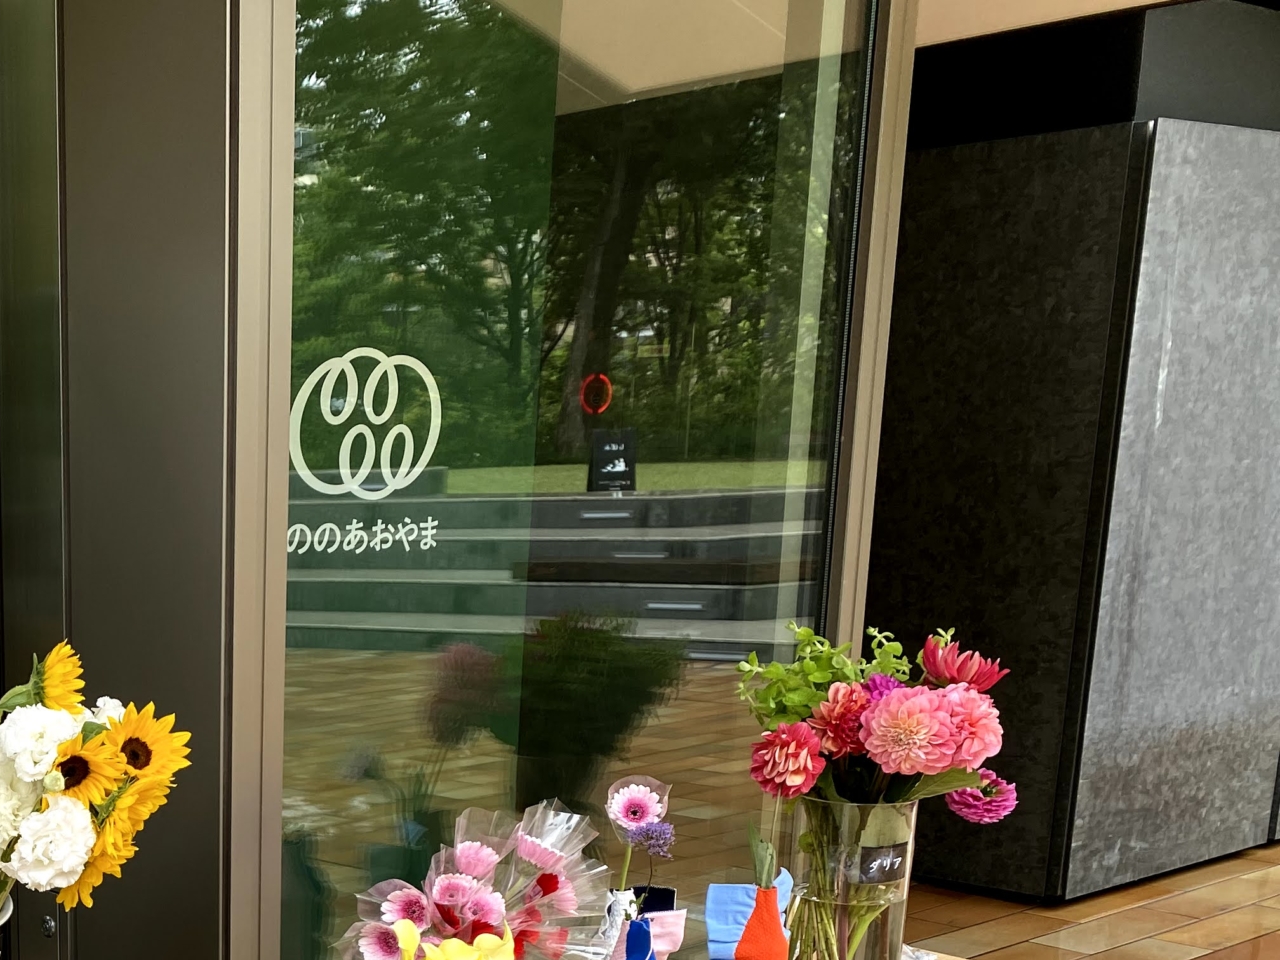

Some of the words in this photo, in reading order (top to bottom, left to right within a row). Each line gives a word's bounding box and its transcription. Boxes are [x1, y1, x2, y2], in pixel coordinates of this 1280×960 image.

[286, 516, 439, 555] ののあおやま
[869, 856, 902, 873] ダリア
